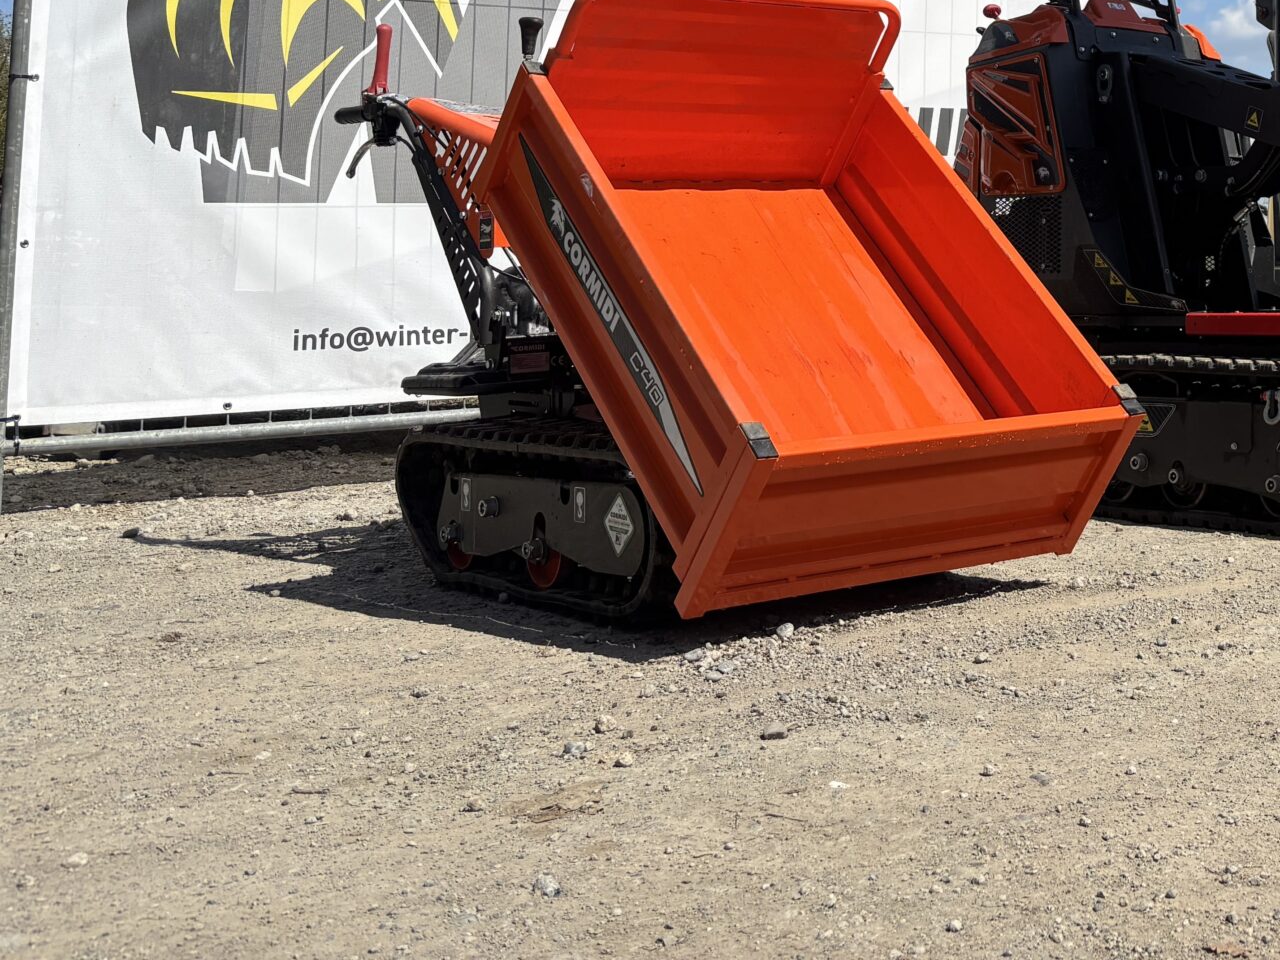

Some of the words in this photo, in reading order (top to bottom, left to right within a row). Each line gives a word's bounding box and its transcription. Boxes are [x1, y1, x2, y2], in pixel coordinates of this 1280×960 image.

[293, 325, 472, 351] info@winter-
[563, 231, 621, 333] CORMIDI
[629, 351, 664, 407] C40
